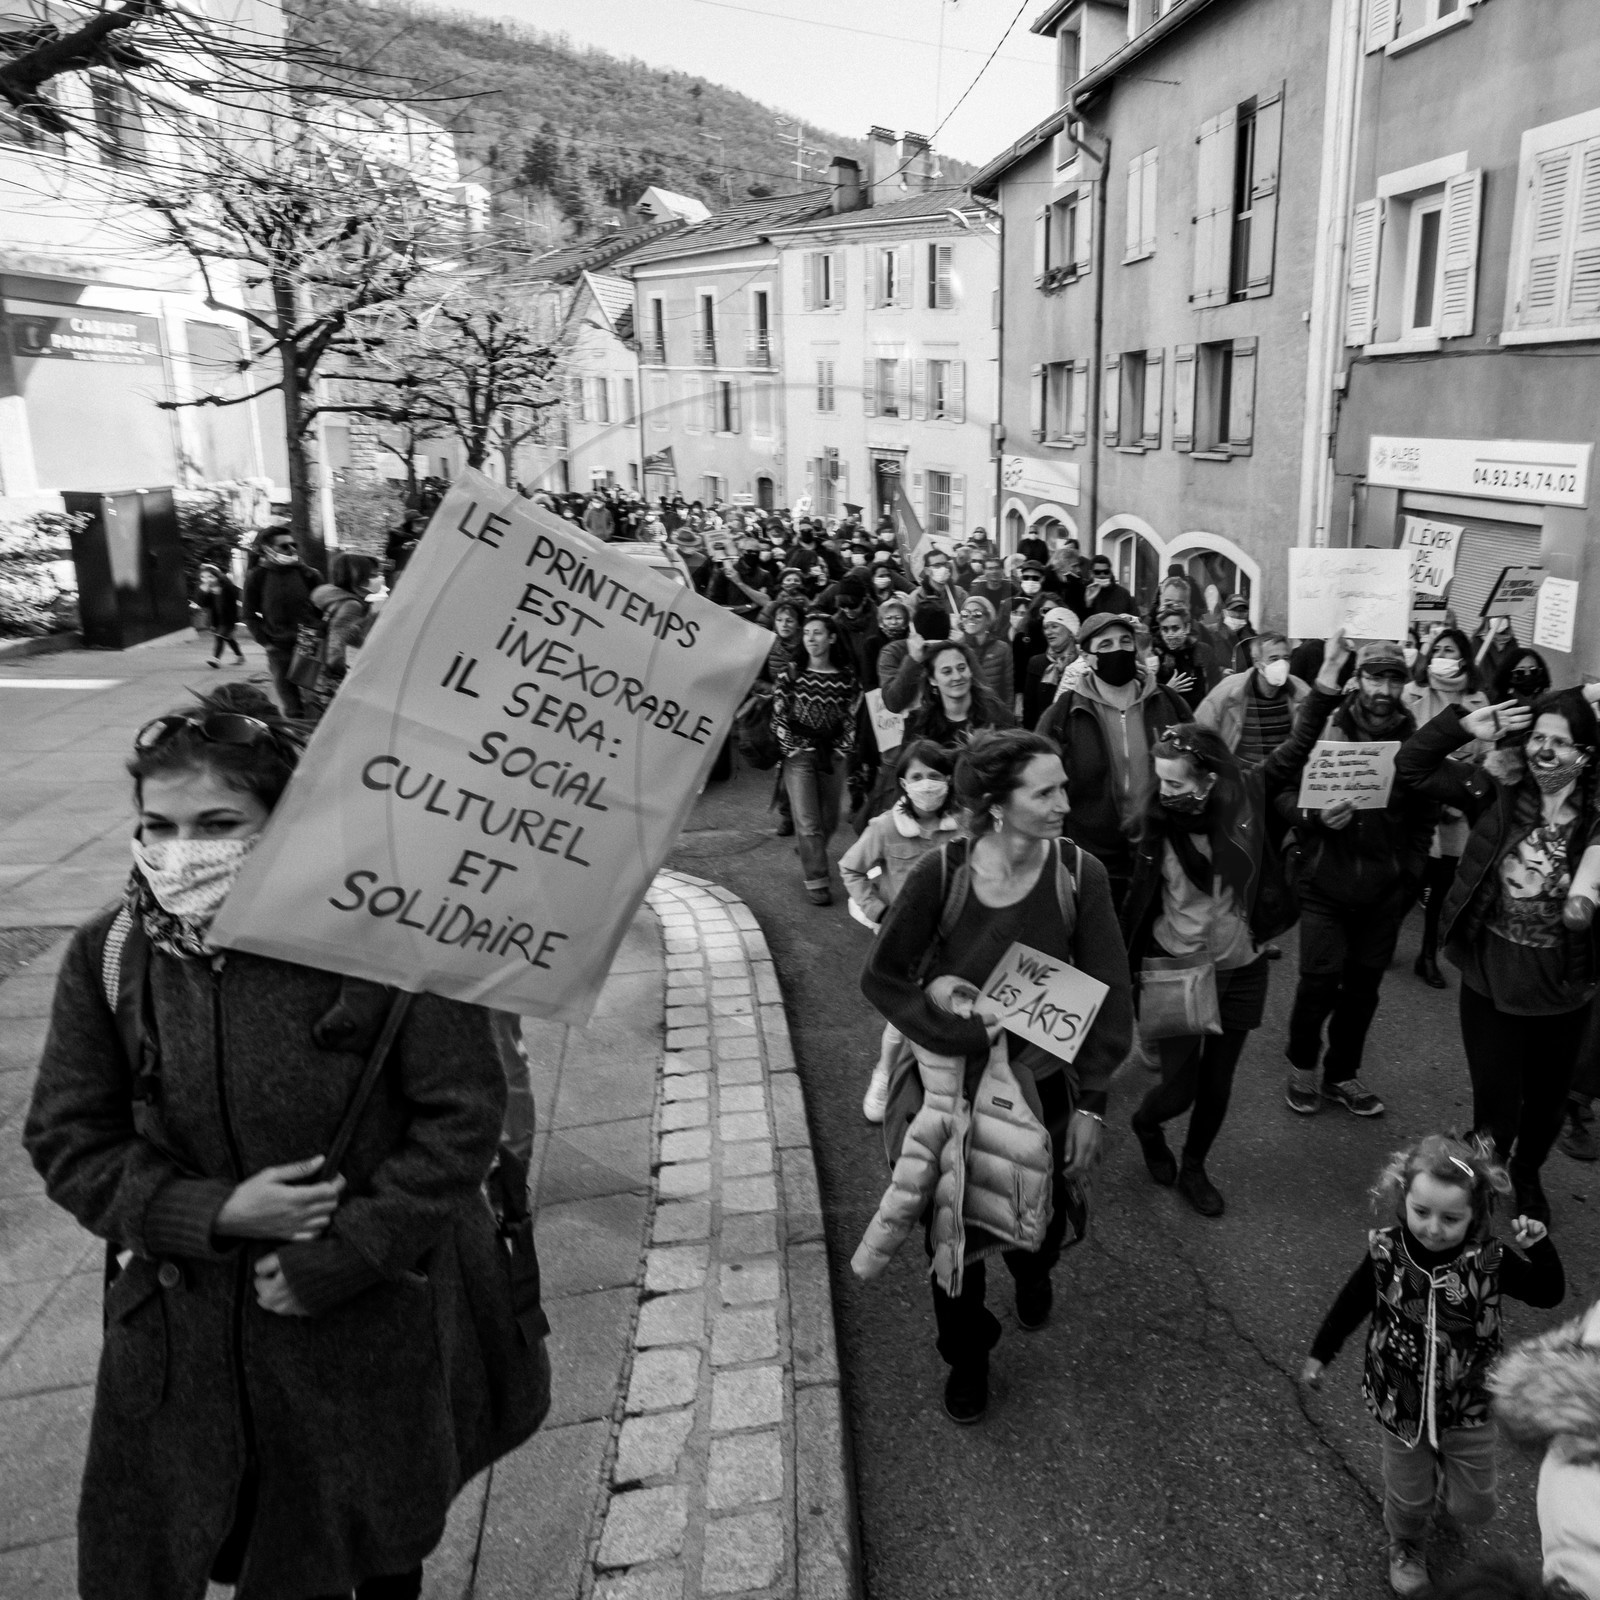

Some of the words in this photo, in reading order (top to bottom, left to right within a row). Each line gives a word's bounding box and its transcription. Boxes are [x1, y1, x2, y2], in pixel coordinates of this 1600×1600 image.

[1472, 467, 1576, 493] 04.92.54.74.02
[457, 502, 511, 549] LE
[1416, 549, 1434, 563] DE
[516, 583, 605, 638] EST
[361, 754, 590, 867] CULTUREL
[448, 848, 518, 894] ET
[986, 972, 1022, 1008] LES
